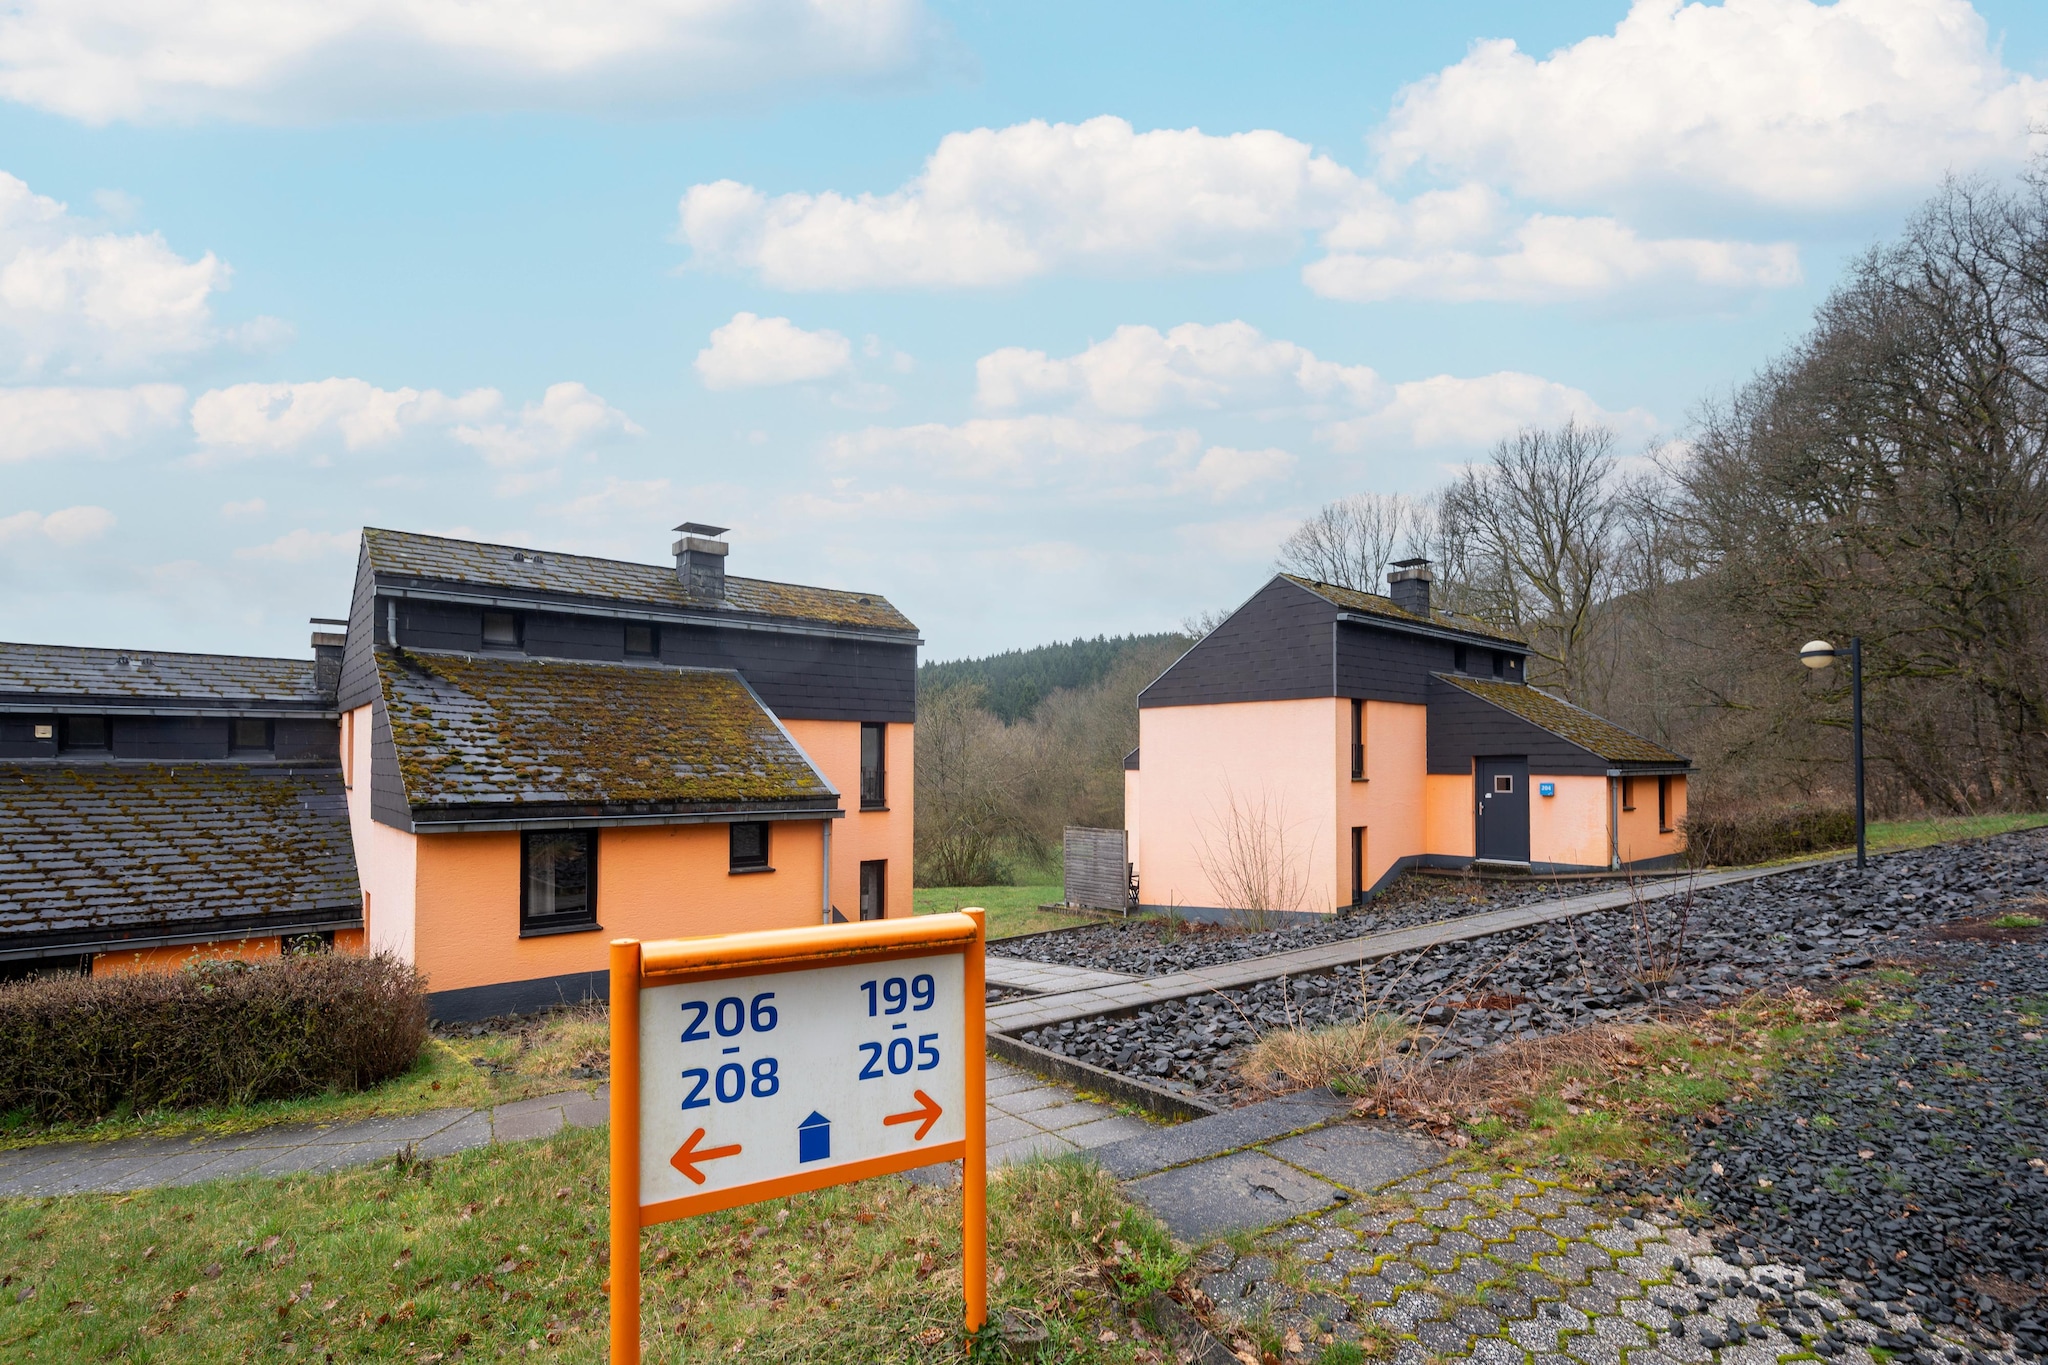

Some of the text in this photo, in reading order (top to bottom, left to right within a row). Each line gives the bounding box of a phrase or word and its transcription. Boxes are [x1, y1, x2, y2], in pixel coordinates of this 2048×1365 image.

[681, 992, 778, 1042] 206
[860, 974, 935, 1016] 199
[858, 1033, 940, 1081] 205
[681, 1057, 780, 1111] 208
